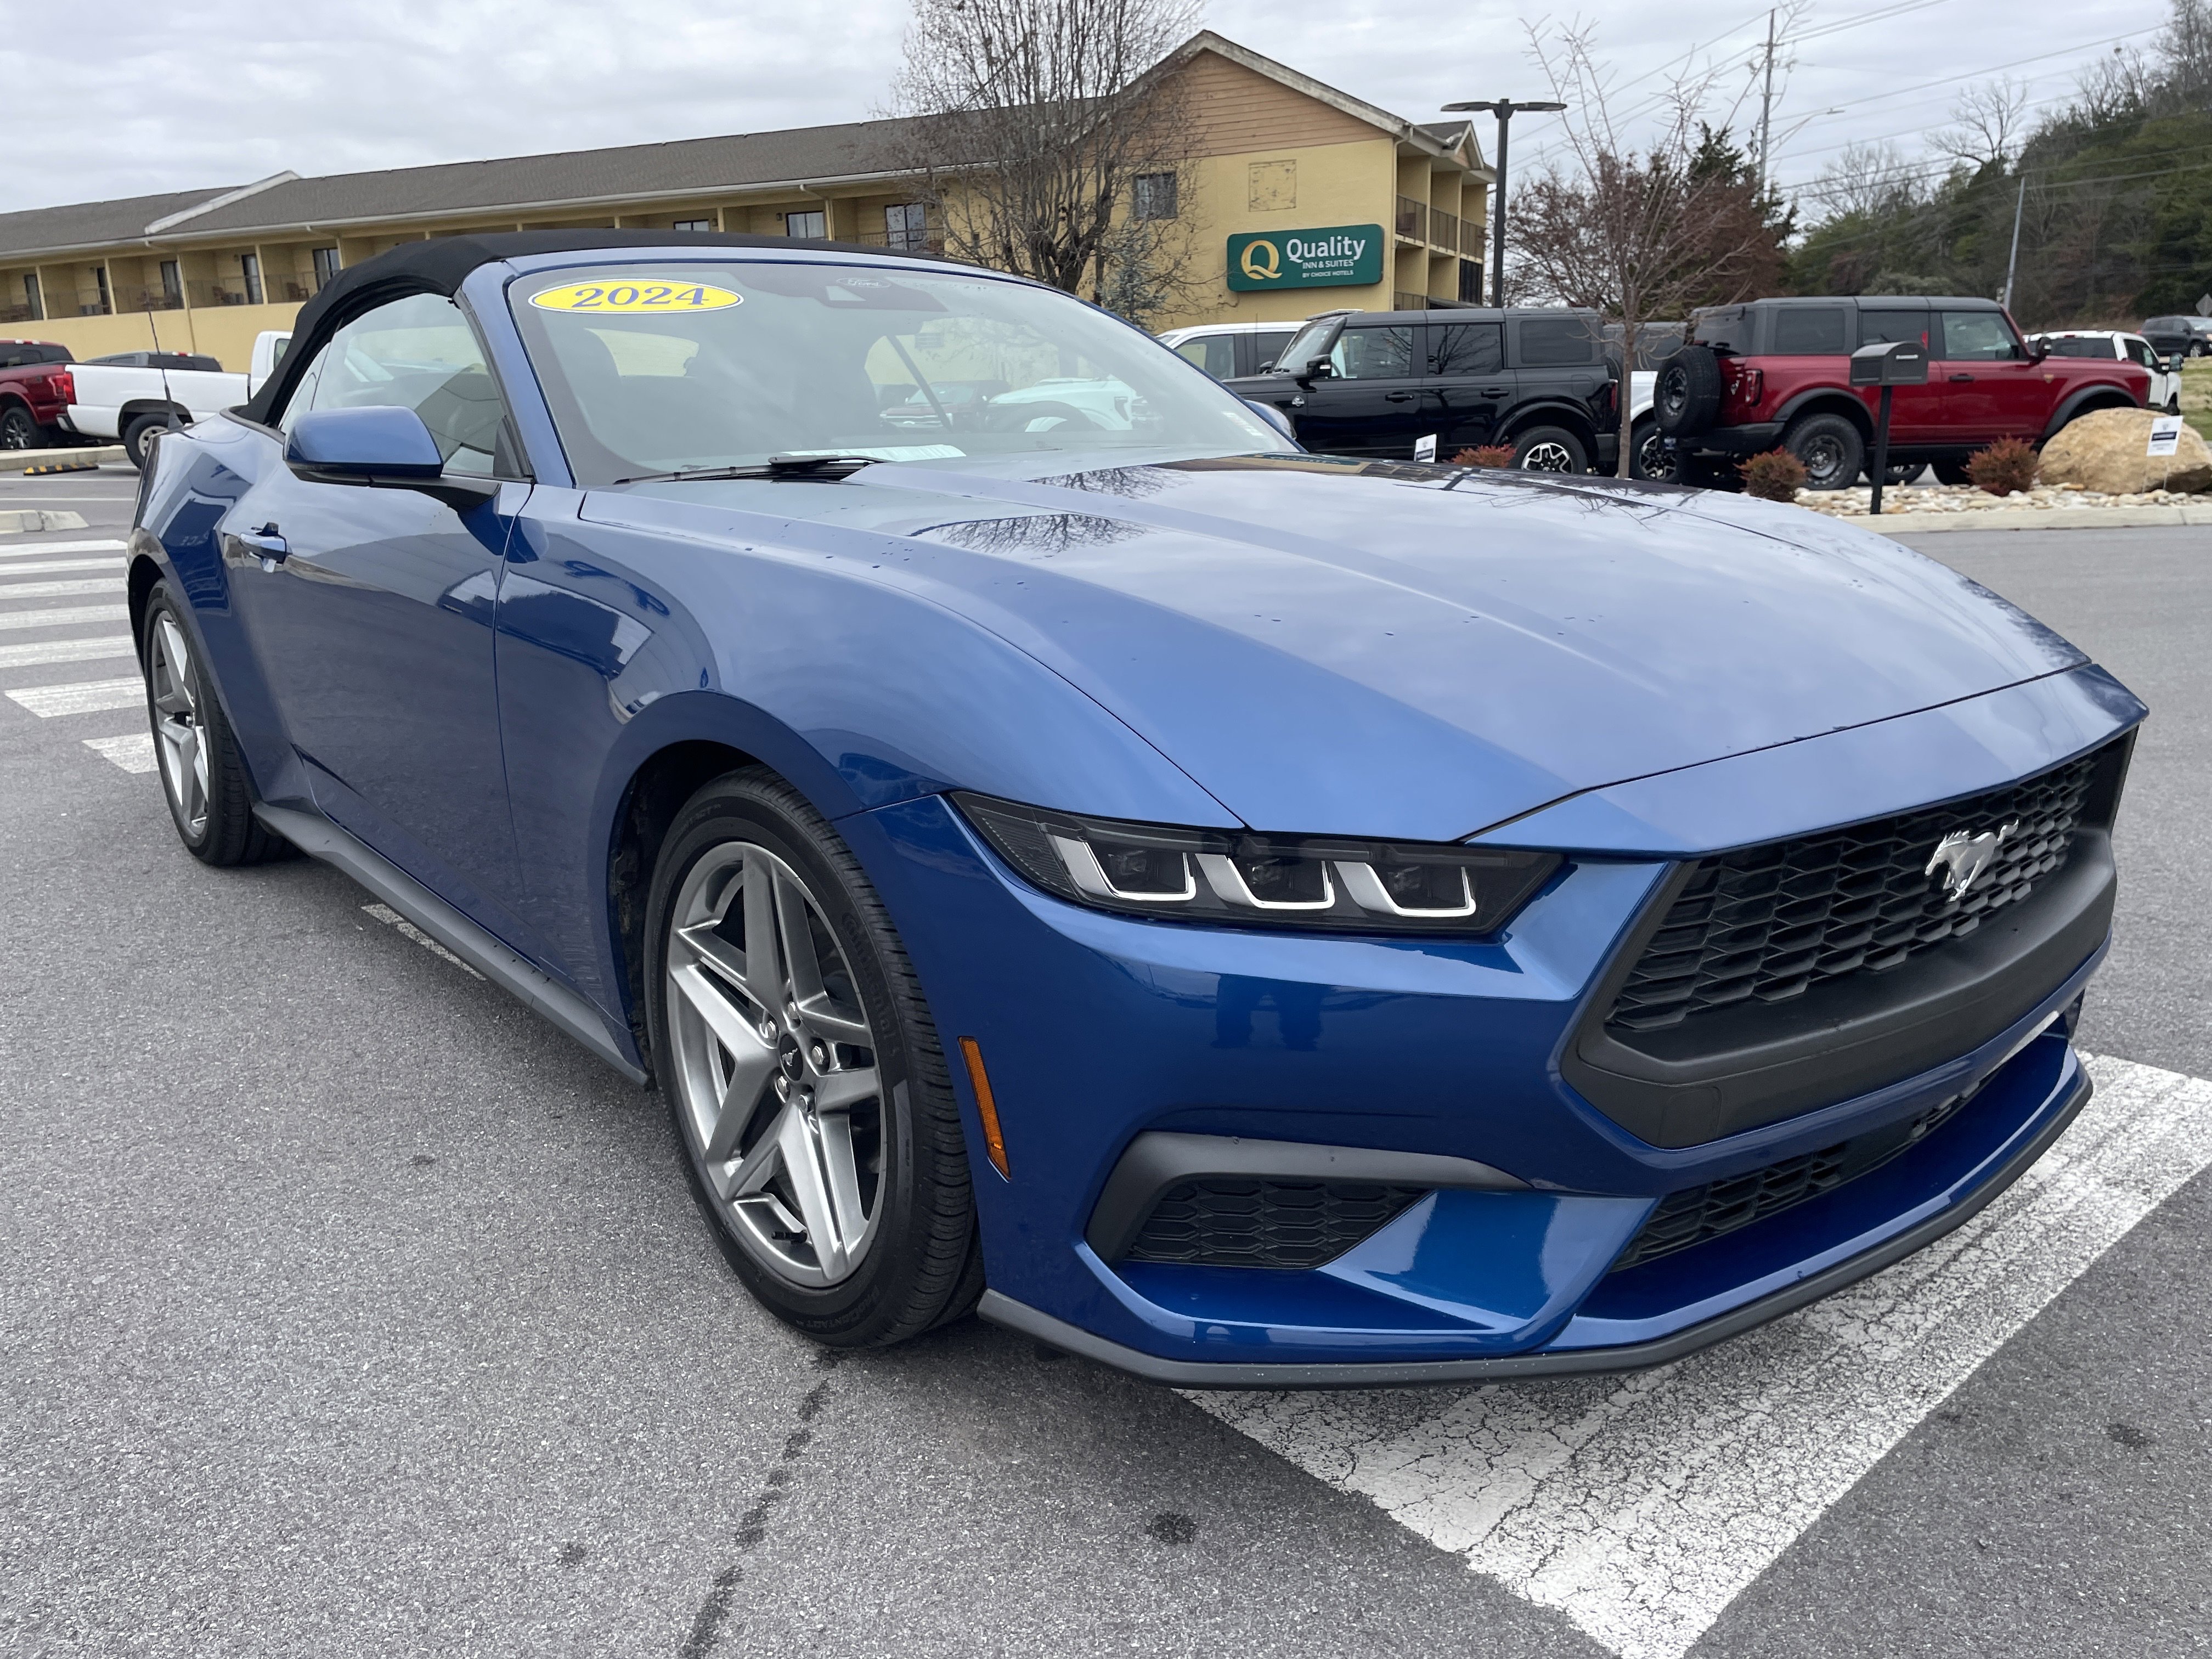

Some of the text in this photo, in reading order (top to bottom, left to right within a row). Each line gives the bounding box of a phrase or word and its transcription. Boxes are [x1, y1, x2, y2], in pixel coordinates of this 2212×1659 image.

[1241, 240, 1283, 280] Q
[1286, 236, 1366, 263] Quality
[572, 287, 709, 308] 2024
